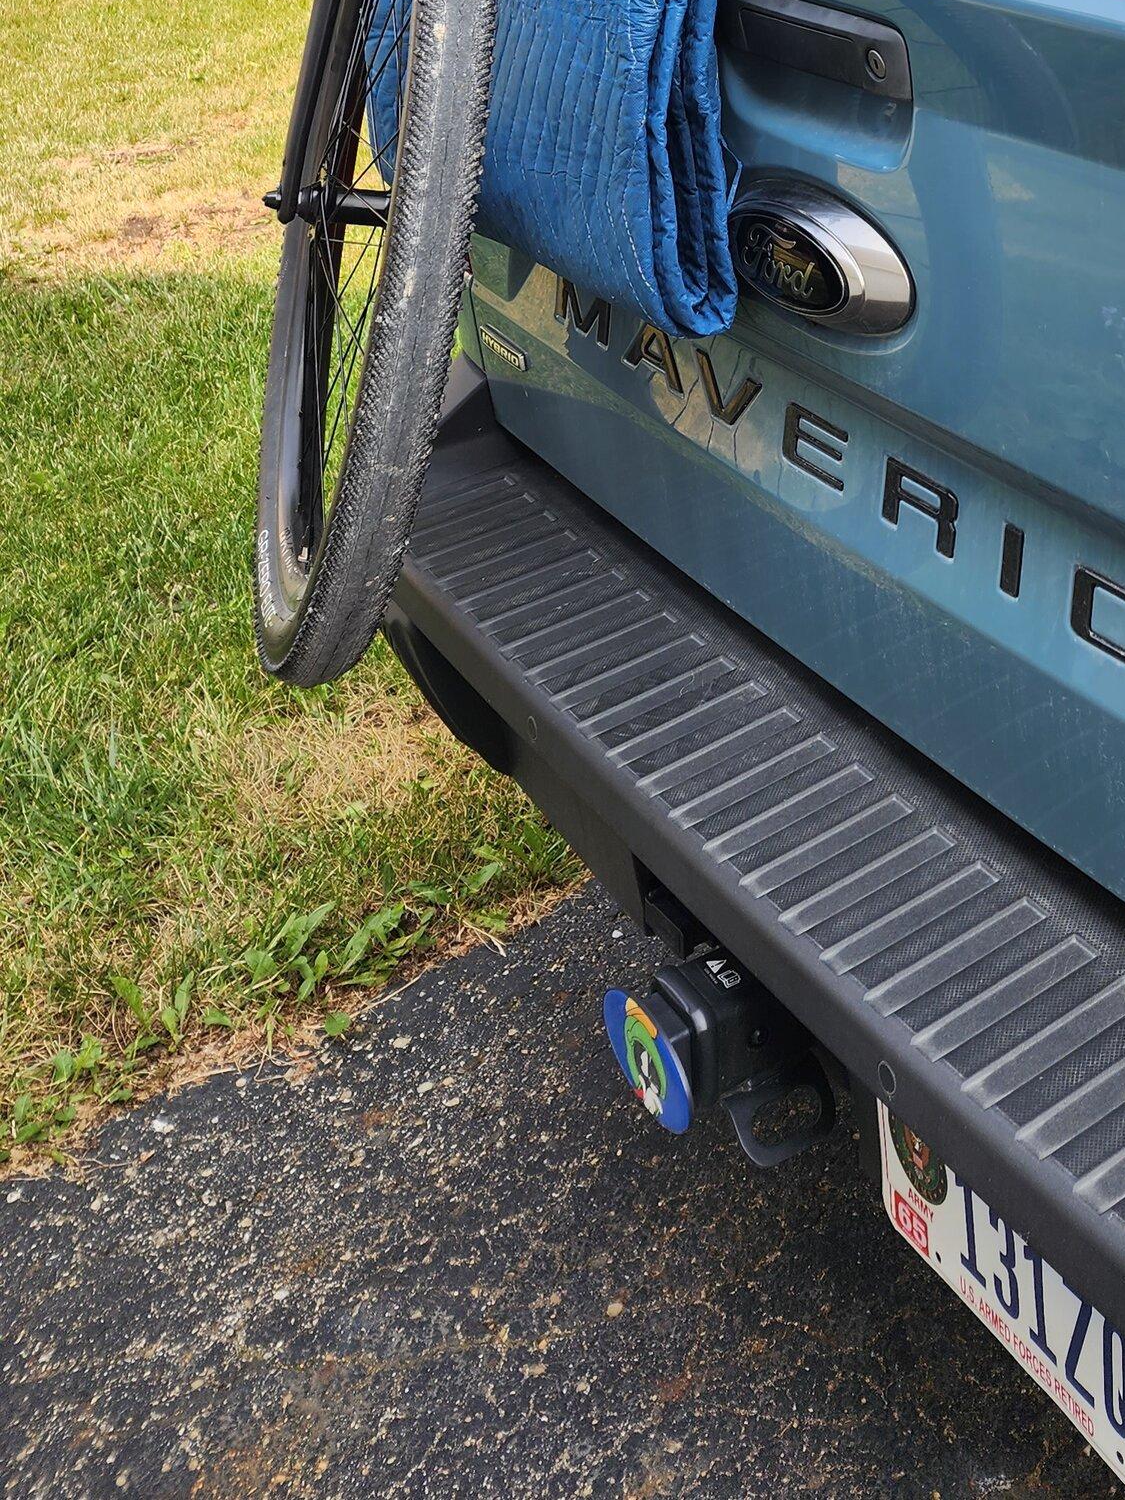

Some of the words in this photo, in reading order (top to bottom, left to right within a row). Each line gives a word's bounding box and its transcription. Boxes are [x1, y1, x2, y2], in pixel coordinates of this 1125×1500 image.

[743, 223, 817, 299] Ford
[482, 331, 519, 368] HYBRID
[898, 1202, 928, 1249] 65
[908, 1188, 934, 1223] ARMY
[959, 1276, 977, 1306] U.S.
[979, 1299, 1011, 1343] ARMED
[1013, 1334, 1053, 1388] FORCES
[1054, 1377, 1095, 1438] RETIRED
